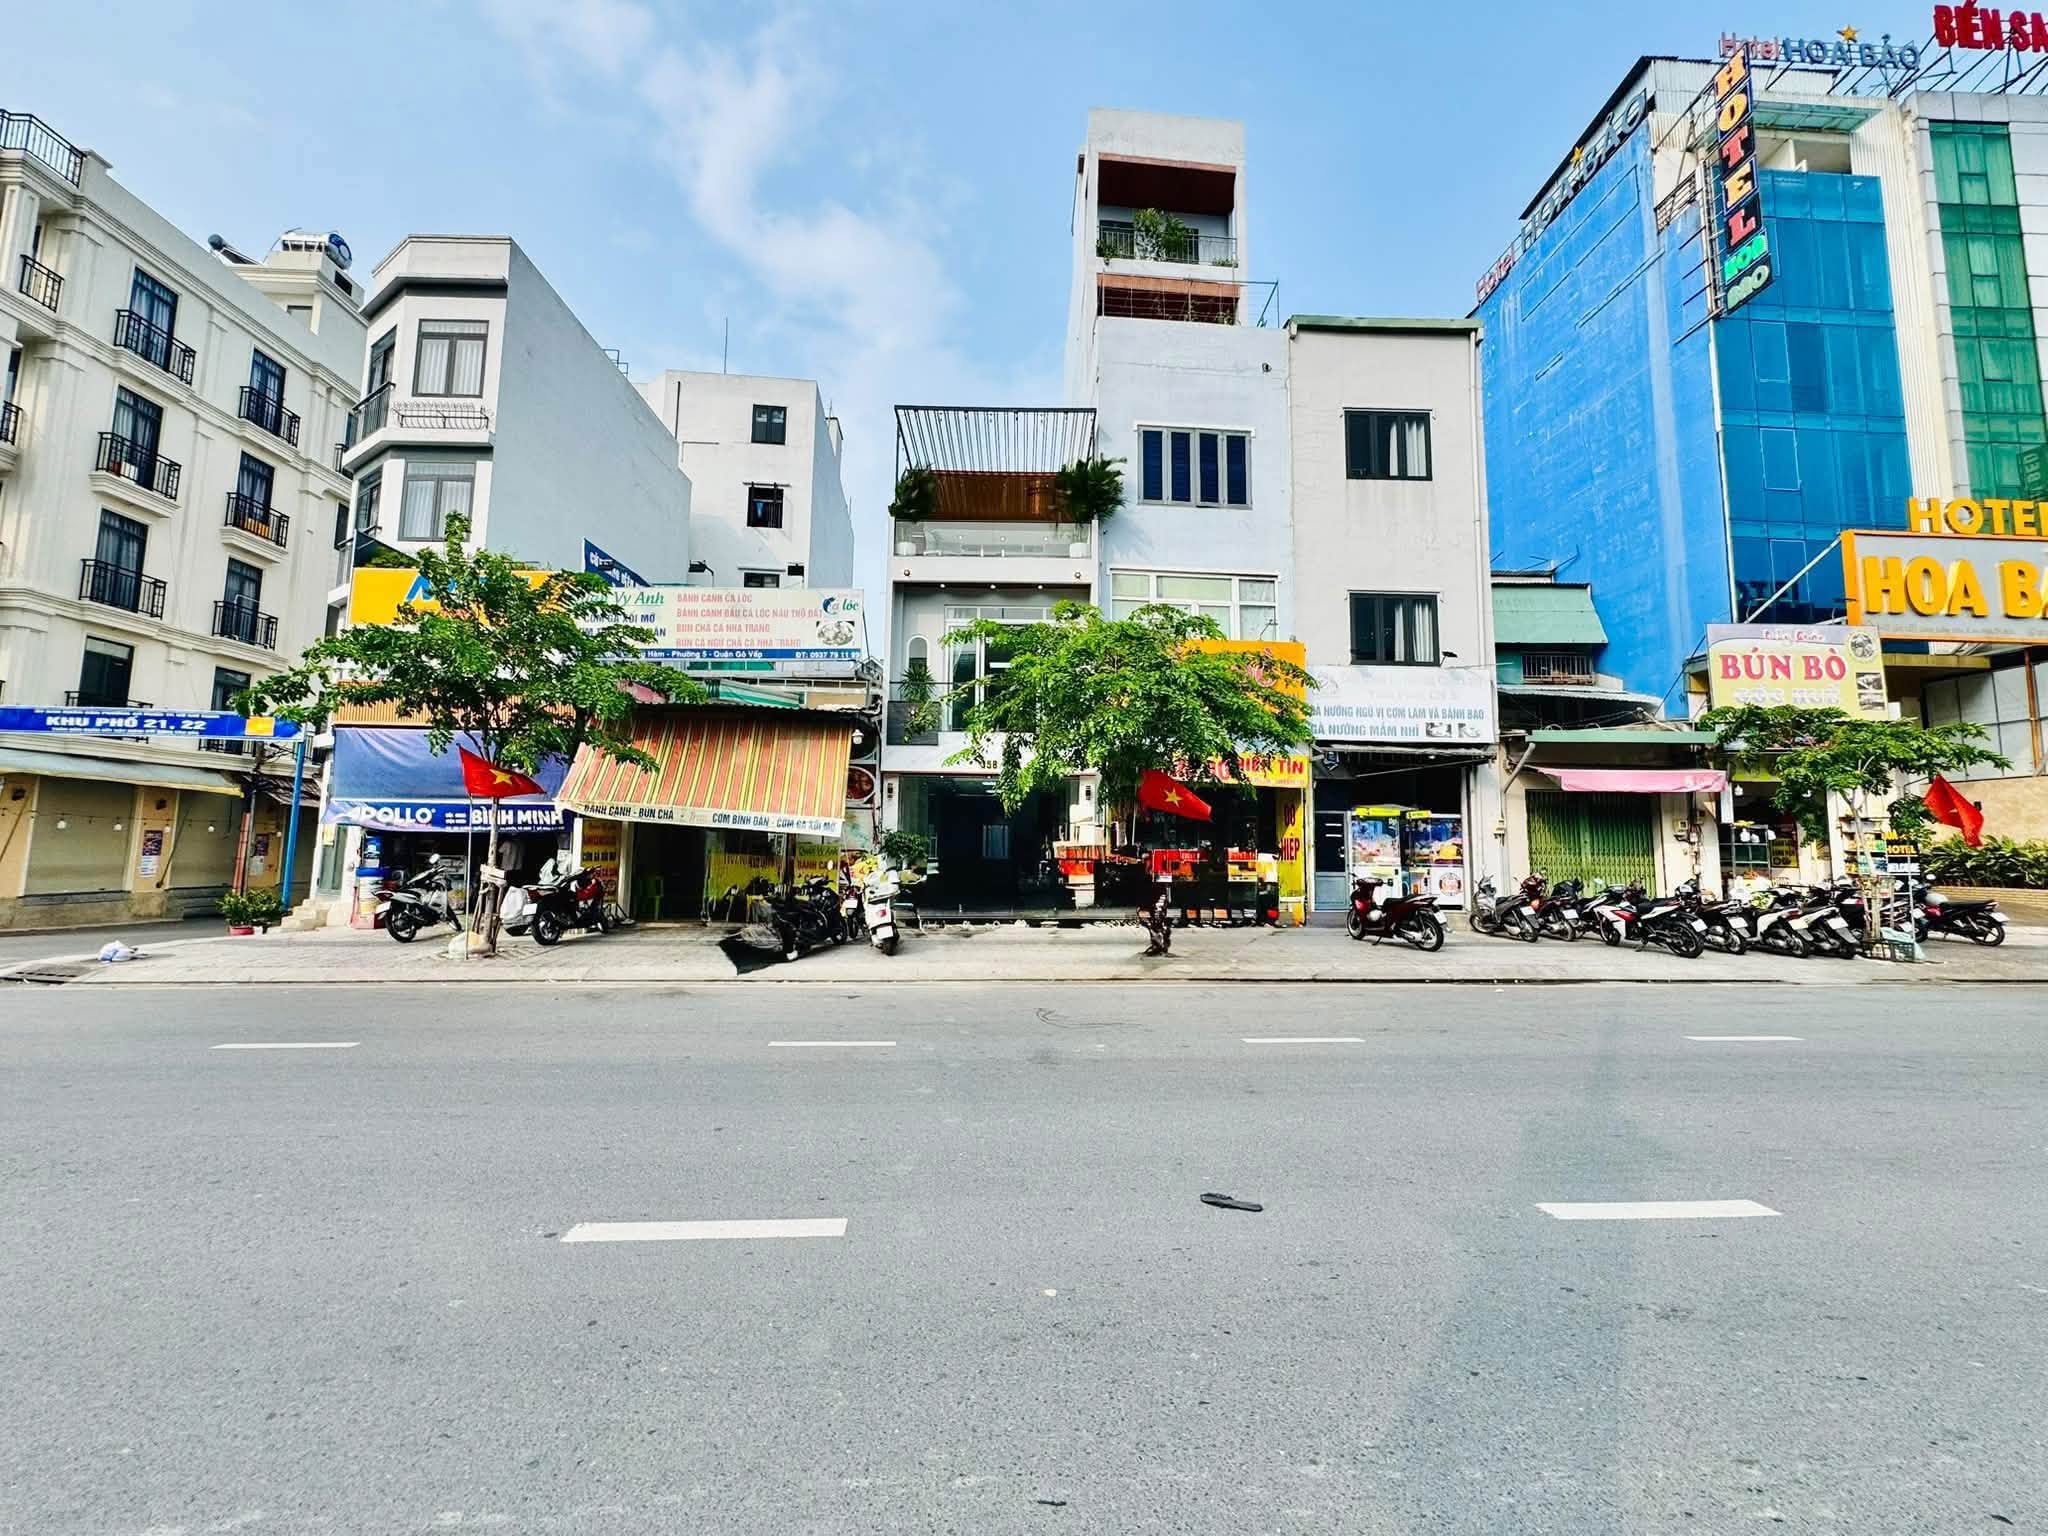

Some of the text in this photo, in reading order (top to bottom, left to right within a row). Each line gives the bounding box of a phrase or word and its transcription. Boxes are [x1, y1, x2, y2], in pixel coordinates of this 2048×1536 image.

[1783, 38, 1851, 66] HOA
[1859, 34, 1920, 70] BẢO
[1715, 48, 1757, 246] HOTEL
[1863, 556, 1989, 617] HOA
[1720, 647, 1847, 680] BÚN BÒ
[46, 716, 90, 726] KHU
[96, 715, 138, 727] PHỐ
[181, 720, 207, 730] 22
[518, 810, 564, 825] MINH
